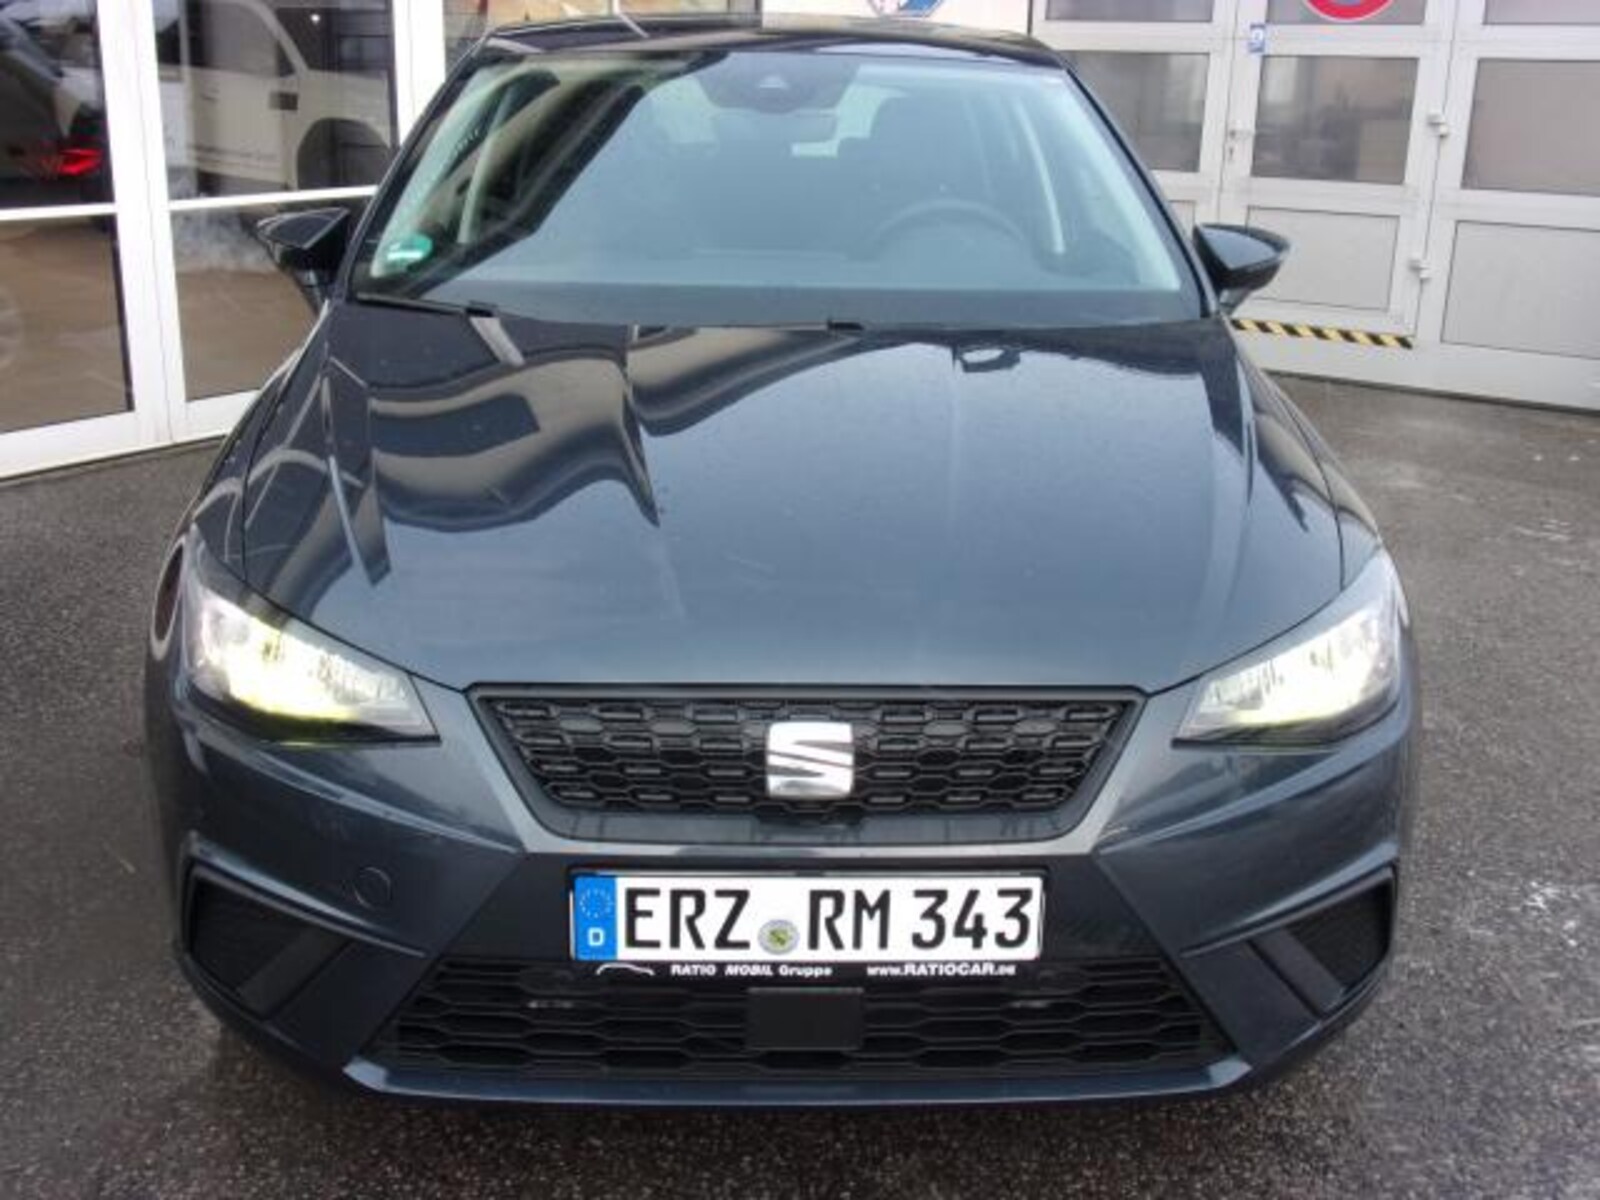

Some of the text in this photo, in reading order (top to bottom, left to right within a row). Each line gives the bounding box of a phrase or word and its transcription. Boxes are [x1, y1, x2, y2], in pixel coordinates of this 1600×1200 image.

[587, 887, 1034, 950] D ERZ RM 343
[671, 964, 717, 976] RATIO
[724, 964, 774, 976] MOBIL
